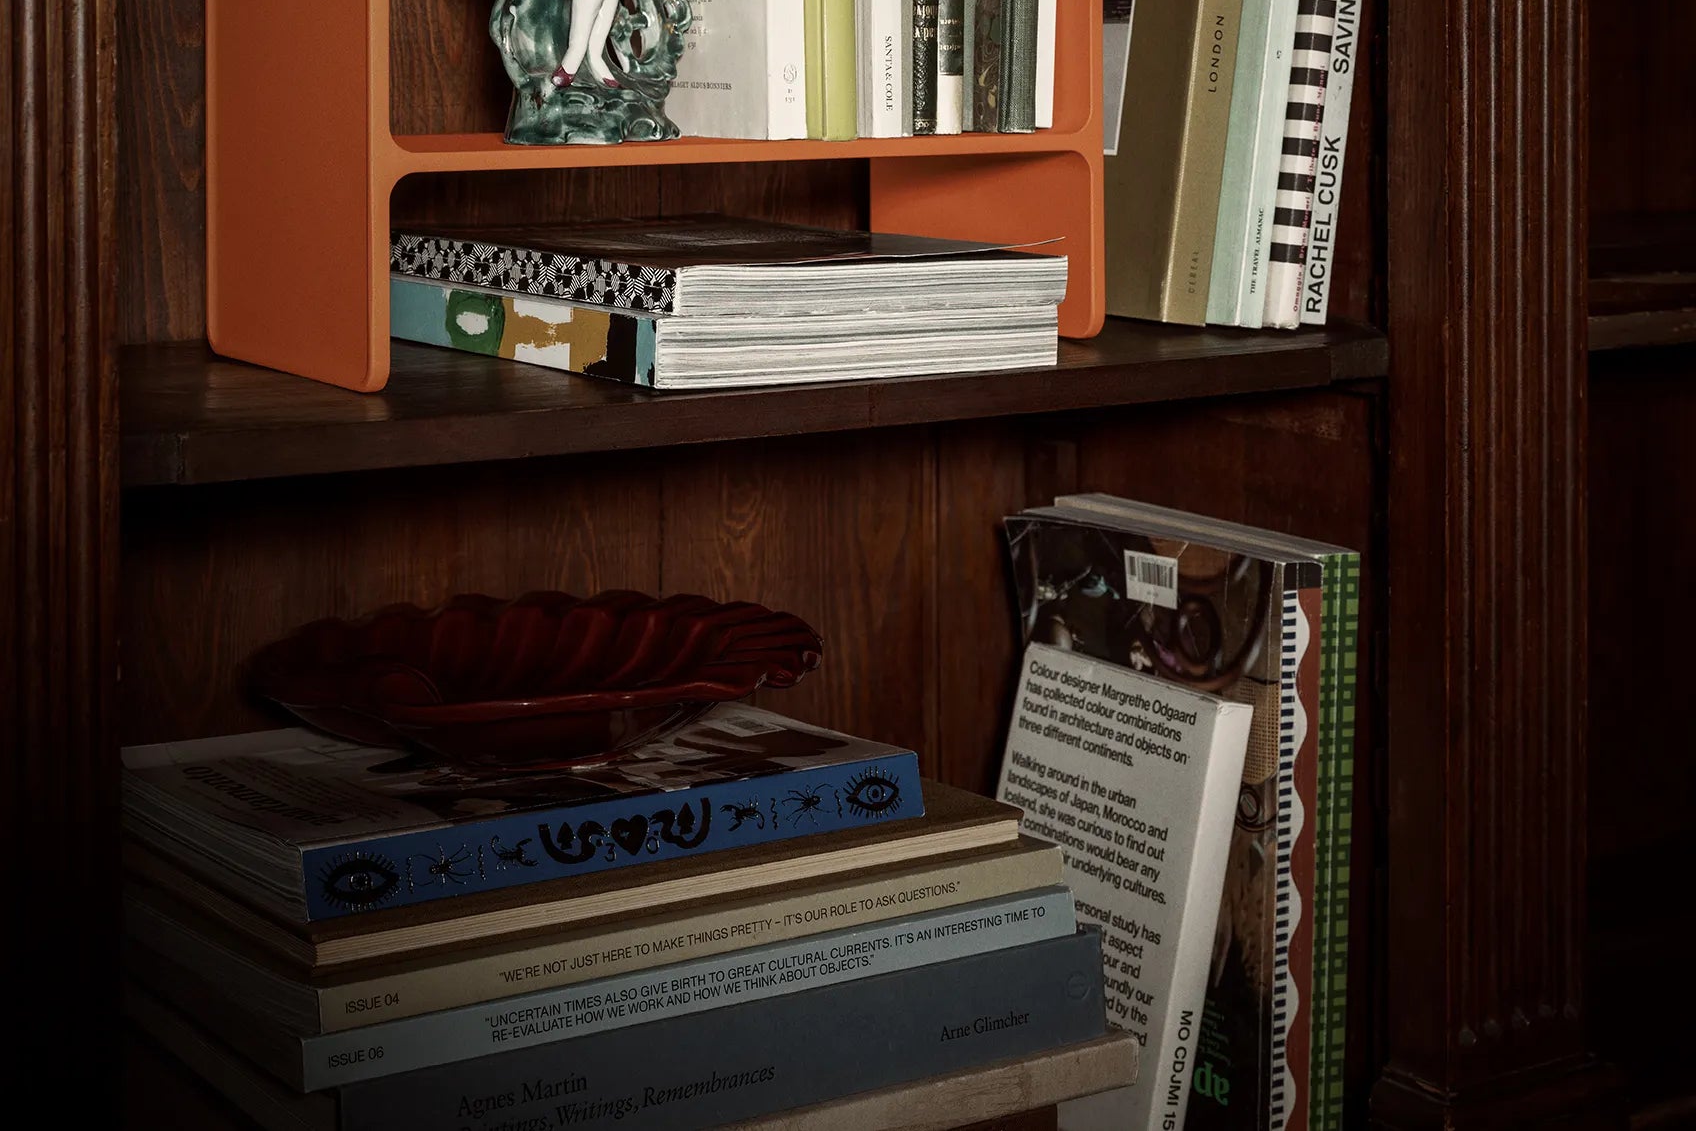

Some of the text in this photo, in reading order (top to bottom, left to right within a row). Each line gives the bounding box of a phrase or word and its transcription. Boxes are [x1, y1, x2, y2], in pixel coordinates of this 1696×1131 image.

[885, 72, 892, 81] &
[1208, 15, 1225, 93] LONDON
[1252, 249, 1260, 276] TRAVEL
[1256, 207, 1264, 244] ALMANAC
[1305, 136, 1341, 313] RACHEL CUSK
[1026, 679, 1182, 742] has collected colour combinations
[1030, 660, 1197, 726] Colour designer Margrethe Odgaard
[1018, 715, 1134, 767] three different continents.
[1022, 697, 1049, 716] found
[1050, 705, 1058, 719] in
[1059, 710, 1115, 740] architecture
[1115, 730, 1134, 746] and
[1135, 736, 1172, 760] objects
[1007, 770, 1169, 841] landscapes of Japan, Morocco and
[1012, 750, 1137, 809] Walking around in the urban
[1004, 788, 1165, 862] Iceland, she was curious to find out
[1023, 817, 1085, 851] combinations
[1086, 840, 1115, 863] would
[1116, 853, 1139, 873] bear
[1140, 864, 1160, 883] any
[1071, 854, 1122, 889] underlying
[1122, 877, 1167, 905] cultures.
[543, 960, 568, 973] NOT
[570, 953, 600, 970] JUST
[602, 947, 632, 963] HERE
[635, 943, 650, 956] TO
[652, 936, 685, 953] MAKE
[686, 927, 729, 947] THINGS
[730, 918, 773, 938] PRETTY
[804, 907, 828, 923] OUR
[830, 902, 857, 918] ROLE
[859, 898, 874, 911] TO
[875, 894, 897, 908] ASK
[564, 996, 602, 1012] TIMES
[604, 988, 638, 1005] ALSO
[640, 981, 668, 997] GIVE
[671, 974, 706, 991] BIRTH
[709, 969, 725, 982] TO
[728, 961, 766, 979] GREAT
[768, 950, 828, 972] CULTURAL
[830, 936, 893, 959] CURRENTS.
[916, 928, 932, 942] AN
[934, 914, 1002, 939] INTERESTING
[1004, 909, 1029, 924] TIME
[1031, 906, 1046, 919] TO
[1108, 933, 1144, 959] aspect
[1112, 915, 1141, 939] study
[1141, 924, 1161, 945] has
[1120, 961, 1142, 979] and
[1135, 989, 1154, 1006] our
[345, 992, 400, 1014] ISSUE 04
[492, 1017, 573, 1043] RE-EVALUATE
[575, 1009, 604, 1026] HOW
[607, 1004, 625, 1018] WE
[627, 998, 665, 1014] WORK
[666, 992, 692, 1007] AND
[693, 986, 721, 1001] HOW
[723, 981, 742, 995] WE
[743, 973, 778, 990] THINK
[779, 968, 817, 985] ABOUT
[940, 1011, 1030, 1042] Arne Glimcher
[1115, 1000, 1129, 1019] by
[1130, 1005, 1148, 1026] the
[1178, 1010, 1193, 1041] MO
[328, 1046, 384, 1068] ISSUE 06
[1167, 1046, 1187, 1106] CDJMI
[456, 1072, 588, 1120] Agnes Martin
[555, 1065, 776, 1128] Writings, Remembrances
